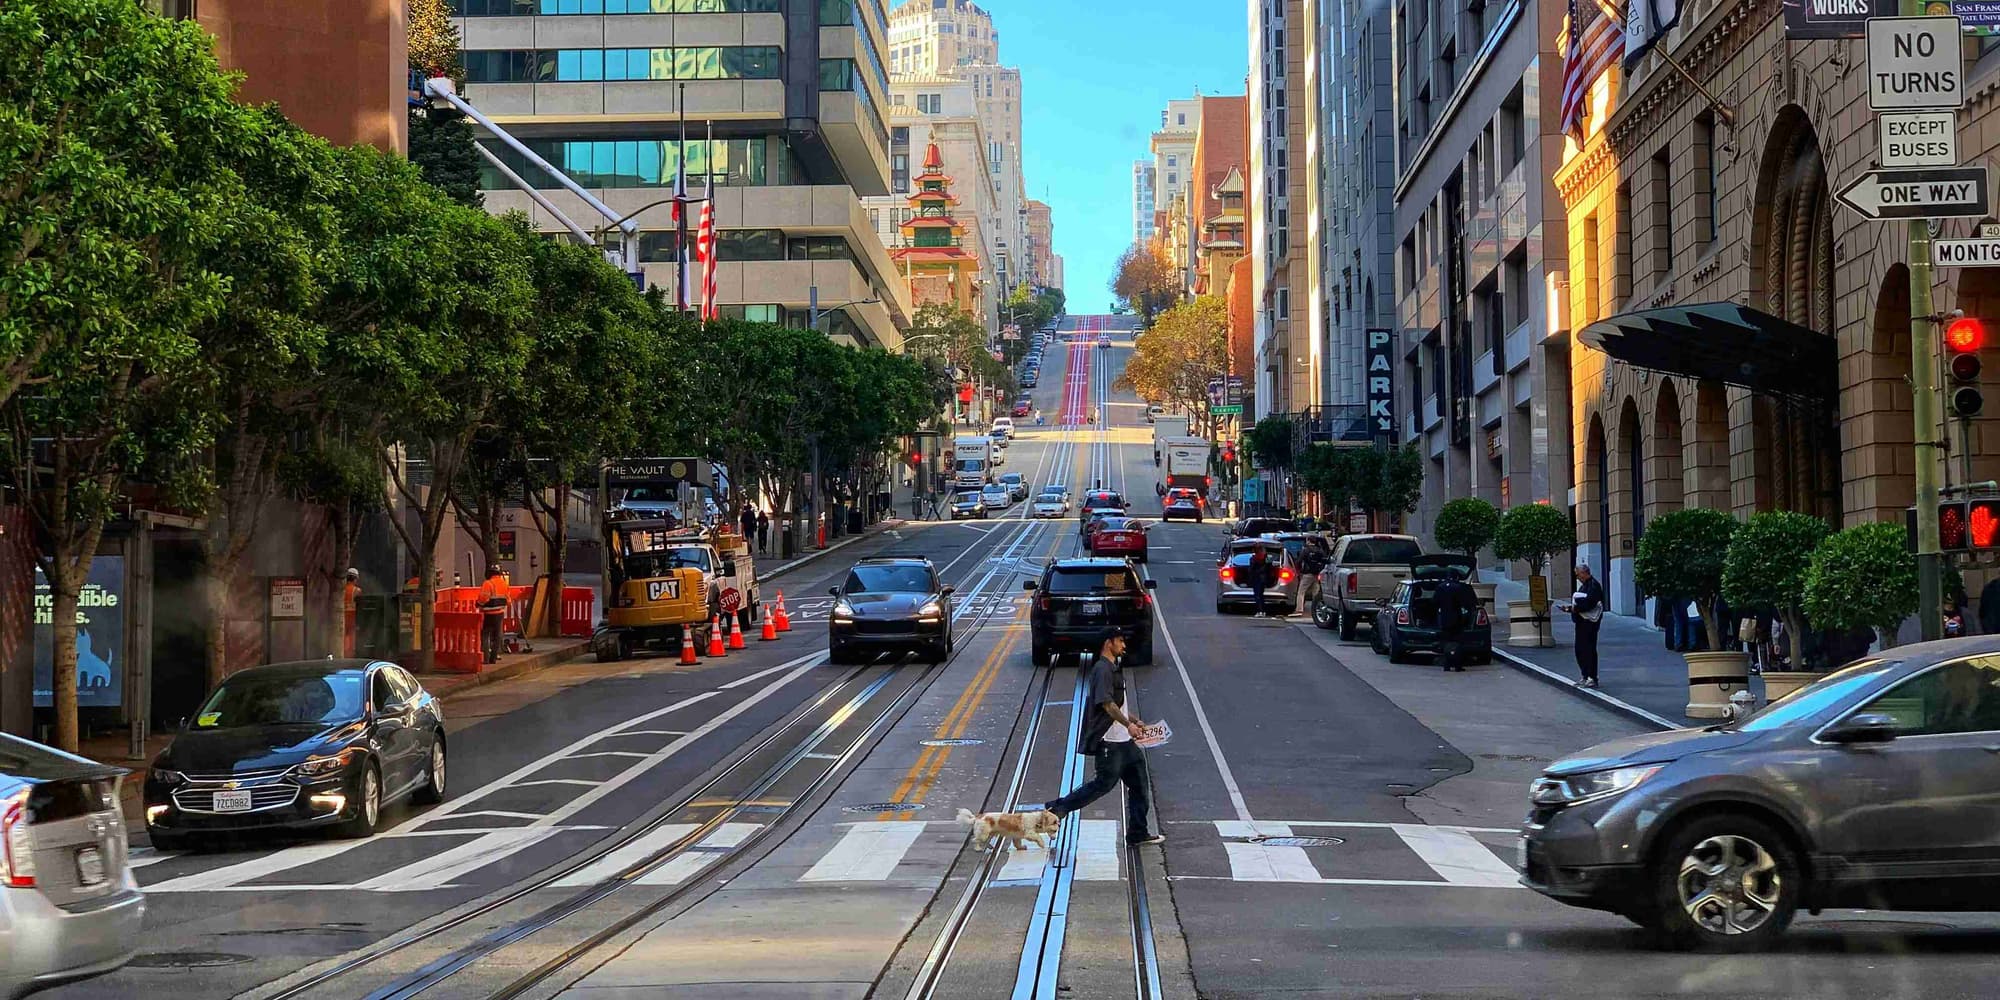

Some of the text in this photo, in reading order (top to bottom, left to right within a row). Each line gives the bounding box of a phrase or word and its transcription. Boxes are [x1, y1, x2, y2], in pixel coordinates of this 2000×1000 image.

[1813, 0, 1868, 15] WORKS
[1894, 32, 1935, 58] NO
[1876, 72, 1956, 94] TURNS
[1889, 121, 1947, 136] EXCEPT
[1889, 143, 1948, 157] BUSES
[1880, 184, 1971, 204] ONE WAY
[1939, 244, 2000, 262] MONTG
[1369, 331, 1392, 417] PARK
[610, 466, 665, 475] HE VAULT
[649, 581, 678, 600] CAT
[720, 591, 740, 608] STOP
